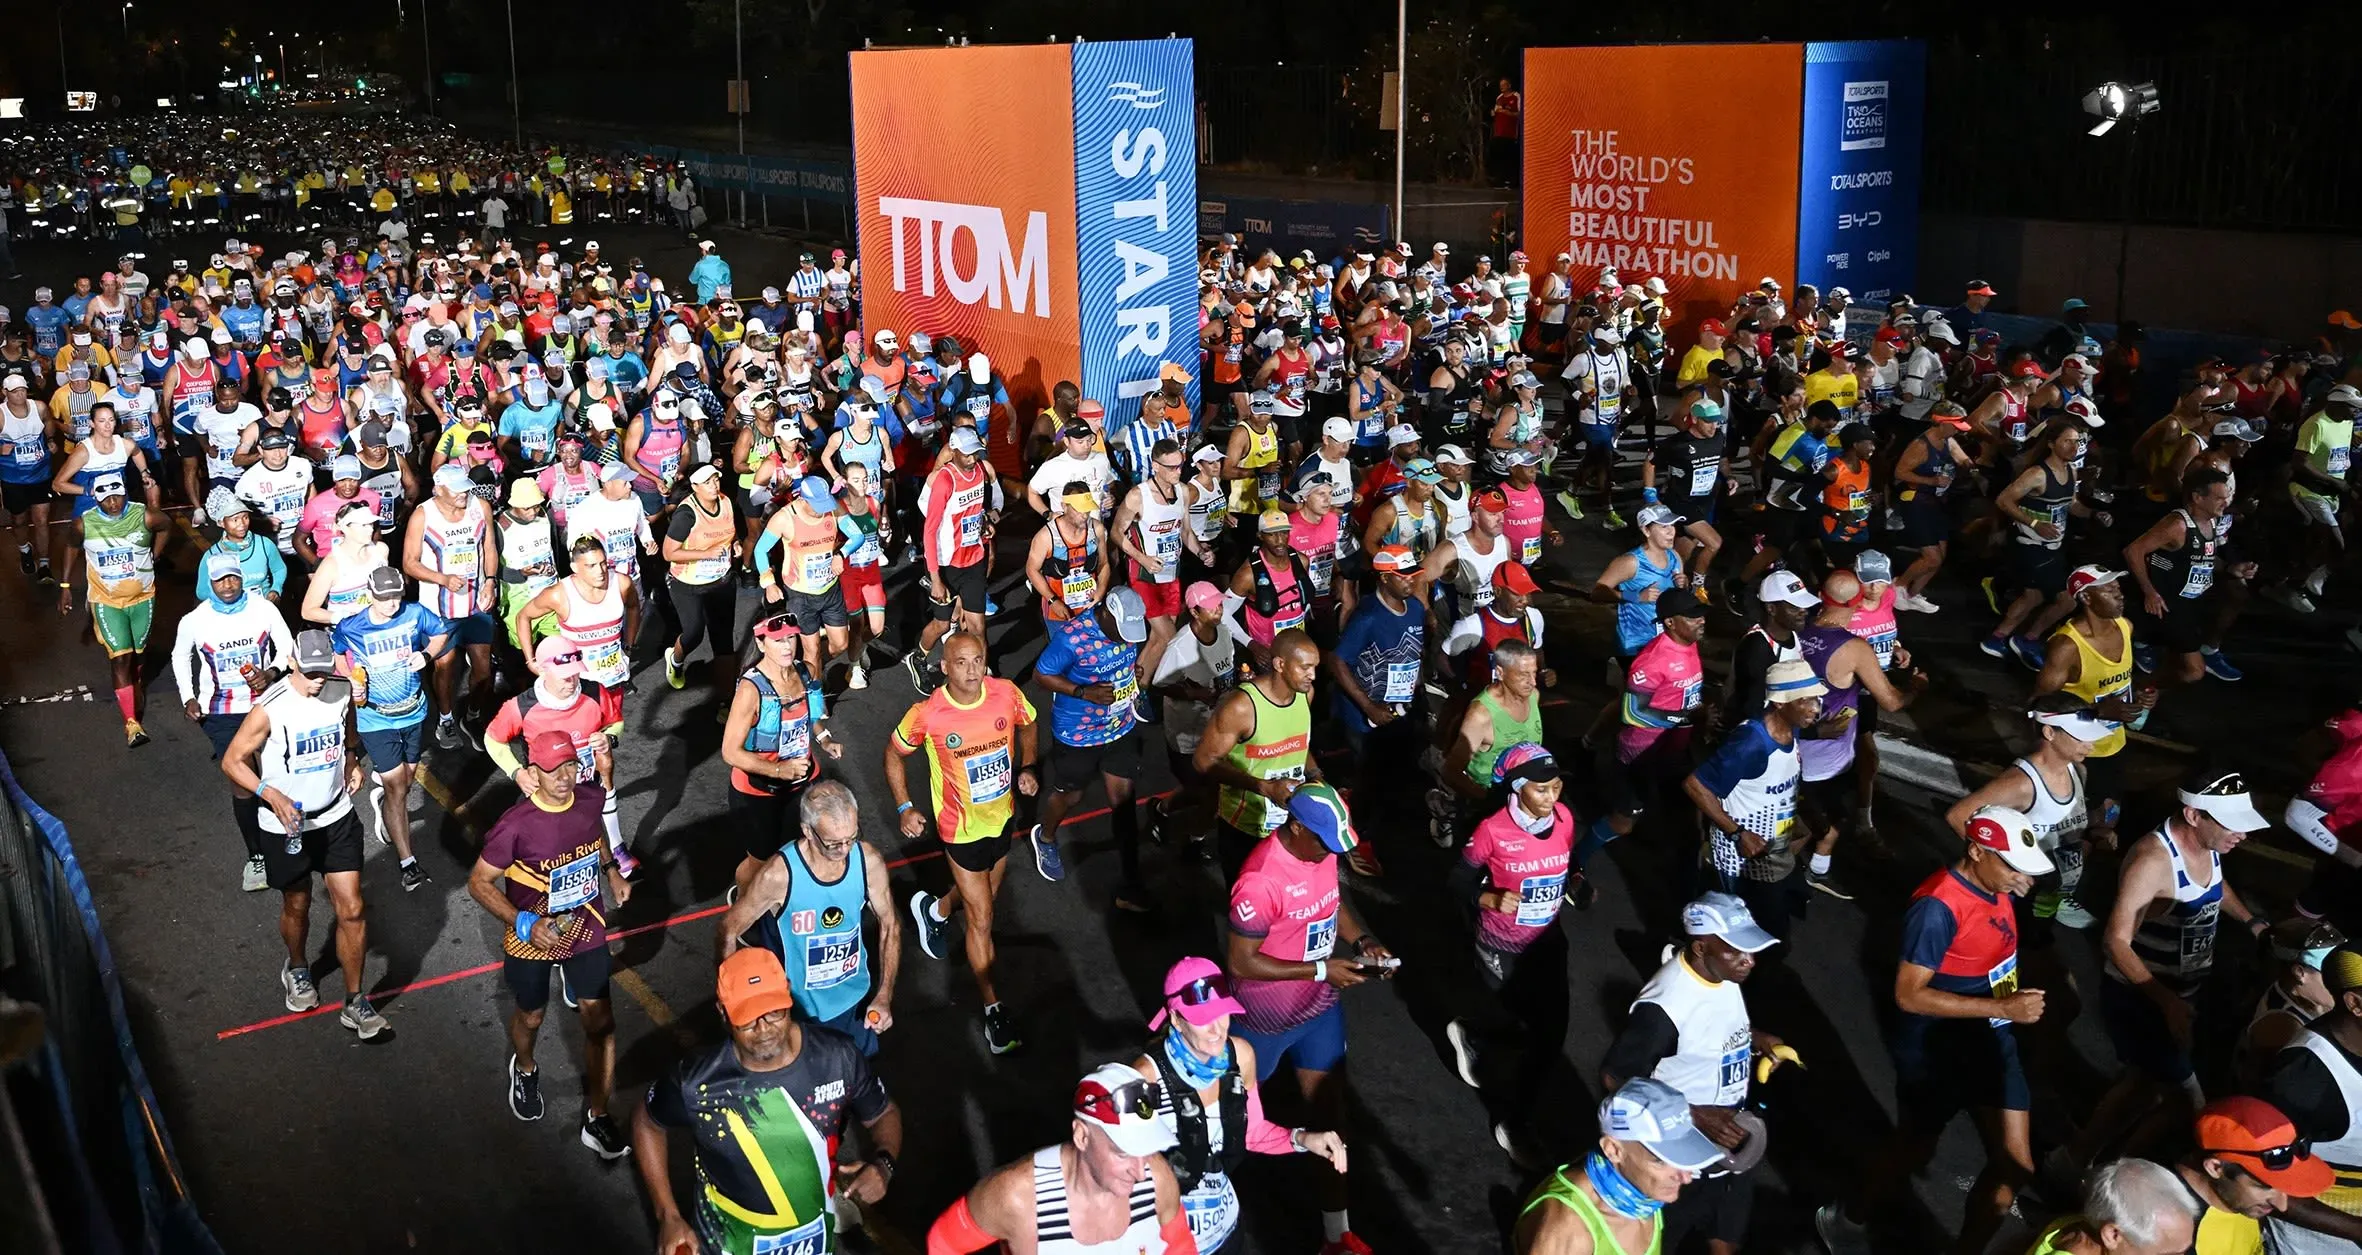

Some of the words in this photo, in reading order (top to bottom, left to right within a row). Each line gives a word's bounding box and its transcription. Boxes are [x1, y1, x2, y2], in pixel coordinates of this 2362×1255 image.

[1848, 86, 1885, 96] TOTALSPORTS
[1847, 117, 1883, 128] OCEANS
[1571, 130, 1618, 157] THE
[1571, 155, 1694, 184] WORLD'S
[1831, 170, 1893, 190] TOTALSPORTS
[1570, 183, 1649, 213] MOST
[1838, 211, 1882, 230] BYD
[1570, 212, 1719, 249] BEAUTIFUL
[1569, 240, 1738, 281] MARATHON
[1827, 253, 1849, 263] POWER
[1867, 250, 1890, 263] Cipla
[185, 380, 212, 388] OXFORD
[128, 399, 140, 409] 65
[1260, 436, 1270, 447] 60
[259, 481, 272, 494] 50
[1332, 487, 1350, 498] ALLIES
[382, 511, 393, 521] 50
[469, 507, 482, 520] 65
[1507, 517, 1527, 527] TEAM
[445, 526, 473, 537] SANDF
[104, 552, 129, 566] J6550
[121, 563, 134, 573] 50
[1067, 579, 1093, 594] J10203
[219, 637, 254, 651] SANDF
[396, 647, 410, 660] 60
[615, 665, 624, 675] 50
[1092, 656, 1125, 674] Addicted
[303, 733, 336, 754] J1133
[953, 744, 988, 758] OMMIEDRAAI
[988, 736, 1008, 750] FRIENDS
[325, 747, 339, 763] 60
[580, 768, 592, 782] 50
[976, 761, 1005, 782] J5556
[999, 770, 1011, 788] 50
[540, 852, 572, 871] Kuils
[1506, 859, 1539, 873] TEAM
[559, 868, 593, 890] J5580
[583, 878, 598, 896] 60
[1528, 884, 1562, 904] J5391
[1288, 903, 1319, 920] TEAM
[791, 911, 815, 933] 60
[820, 943, 852, 964] J257
[842, 954, 859, 972] 60
[814, 1079, 844, 1095] SOUTH
[815, 1087, 846, 1105] AFRICA
